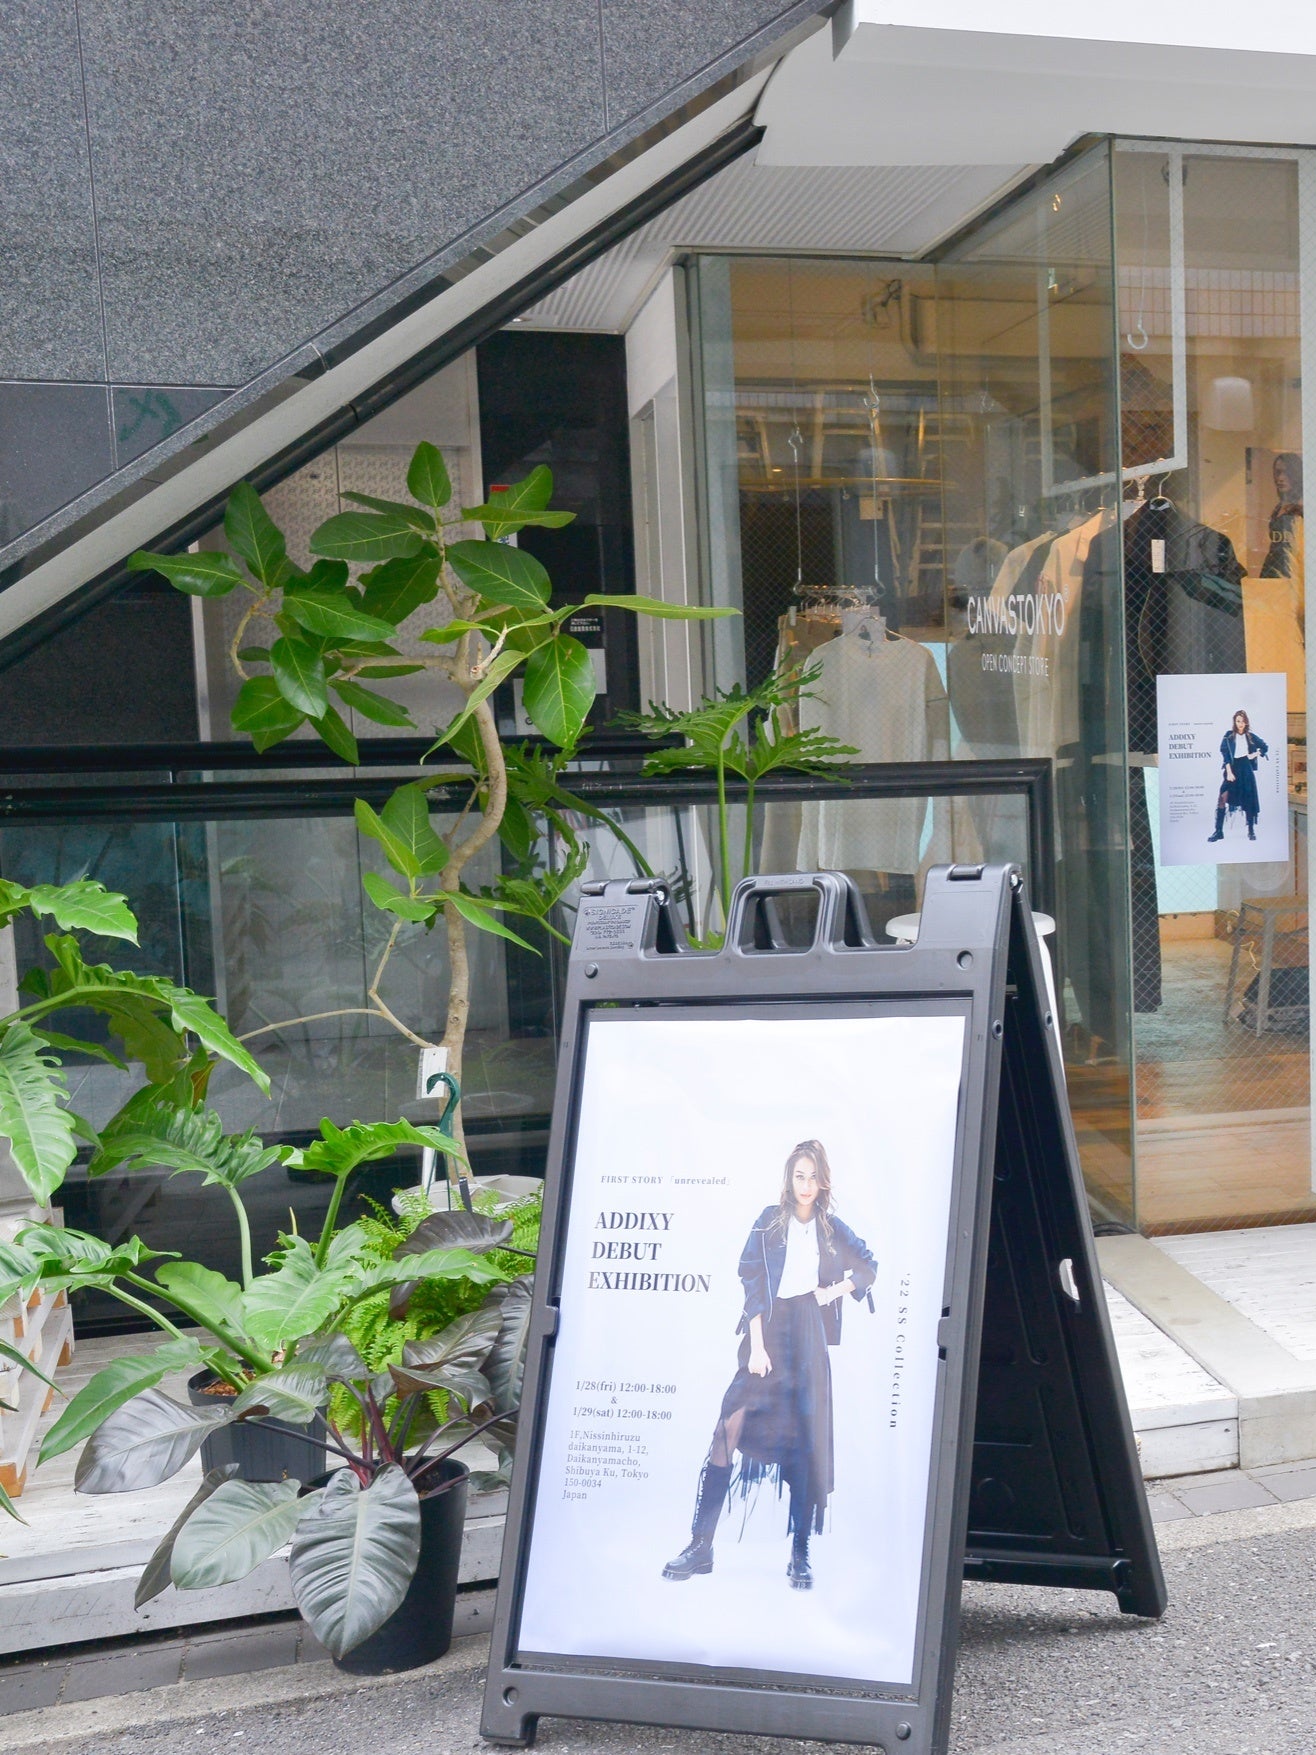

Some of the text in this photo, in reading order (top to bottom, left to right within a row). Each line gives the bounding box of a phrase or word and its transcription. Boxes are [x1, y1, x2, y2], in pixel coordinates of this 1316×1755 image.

[967, 592, 1065, 636] CANVASTOKYO
[982, 653, 1049, 677] OPEN CONCEPT STORE
[600, 1175, 629, 1184] FIRST
[631, 1175, 664, 1185] STORY
[594, 1211, 674, 1231] ADDIXY
[591, 1241, 662, 1261] DEBUT
[588, 1271, 712, 1293] EXHIBITION
[897, 1306, 908, 1325] SS
[575, 1380, 677, 1394] 1/28(fri) 12:00-18:00
[889, 1334, 906, 1428] Collection
[610, 1396, 618, 1405] &
[573, 1406, 672, 1421] 1/29(sat) 12:00-18:00
[568, 1442, 649, 1456] daikanyama, 1-12,
[566, 1454, 641, 1467] Daikanyamacho,
[565, 1466, 649, 1480] Shibuya Ku, Tokyo
[563, 1478, 602, 1488] 150-0034
[562, 1490, 587, 1501] Japan
